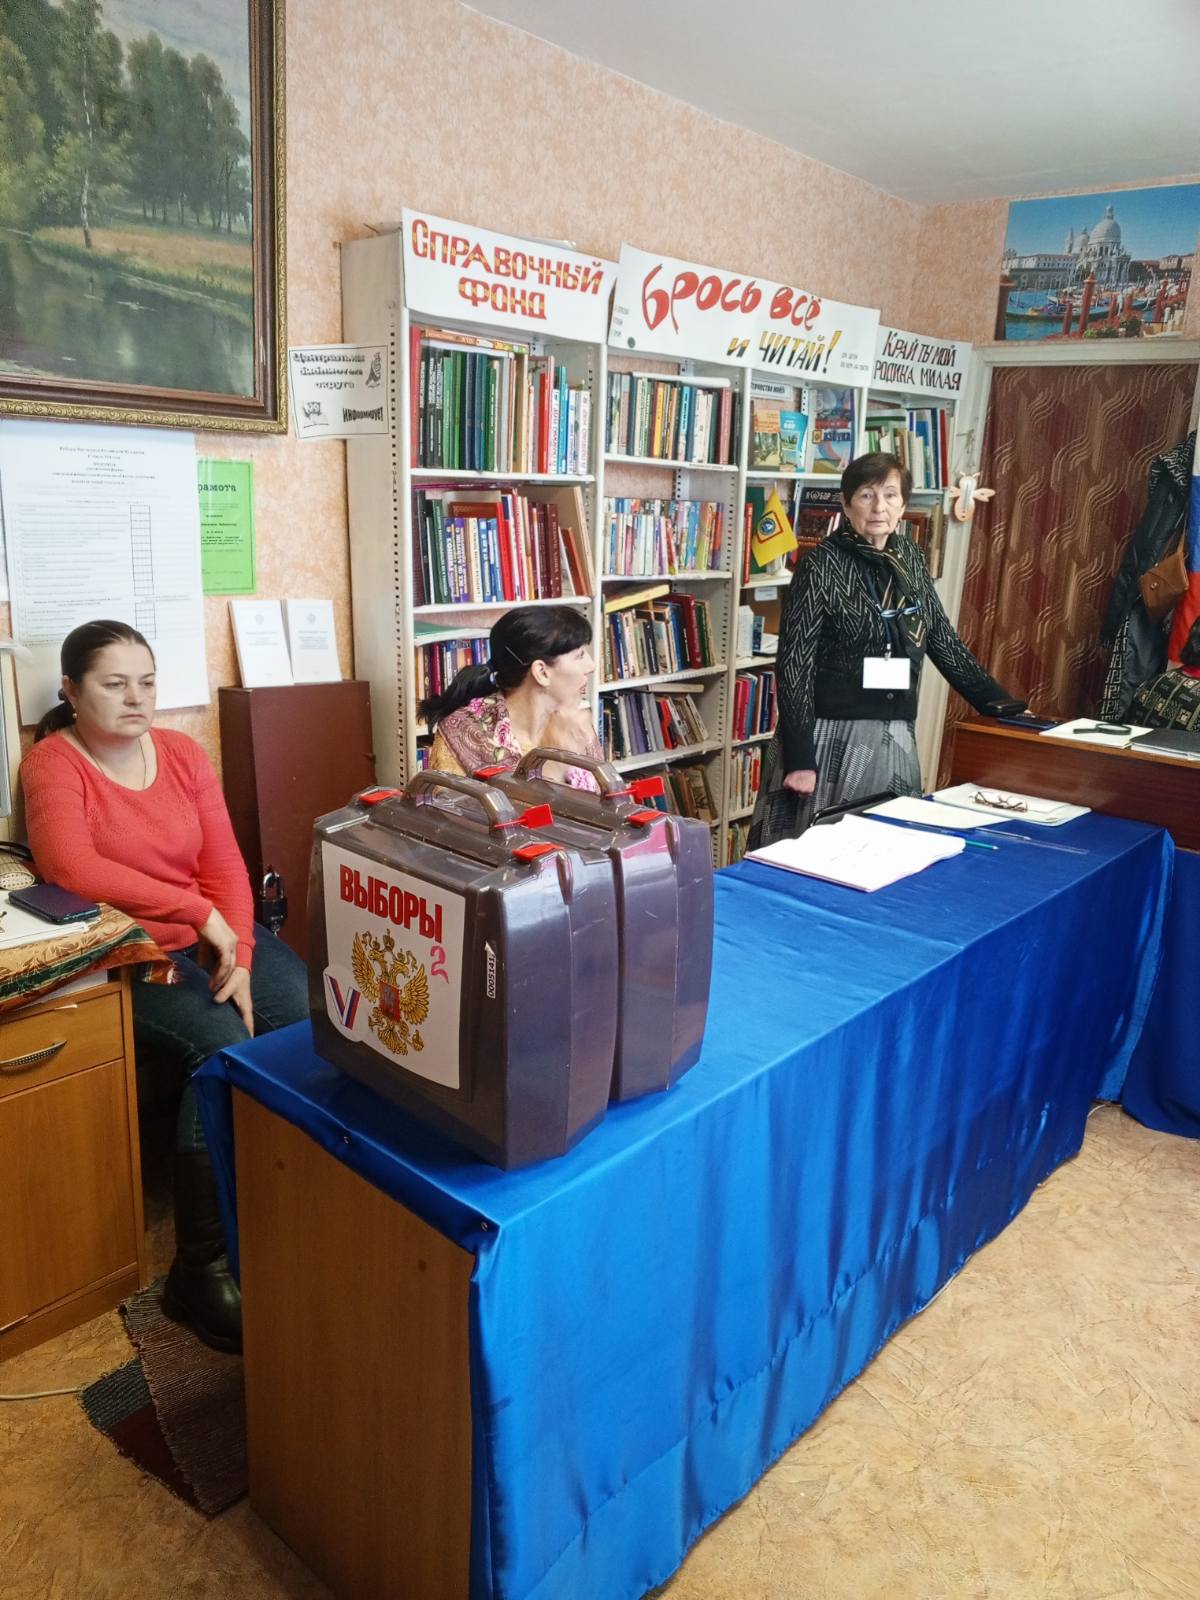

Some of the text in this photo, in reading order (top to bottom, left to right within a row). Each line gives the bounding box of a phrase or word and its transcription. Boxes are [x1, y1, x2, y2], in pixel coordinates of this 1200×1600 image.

[411, 218, 604, 295] СПРАВОЧНЫЙ
[458, 276, 547, 320] ФОНД
[917, 343, 934, 363] ТЫ
[874, 360, 962, 391] РОДИНА МИЛАЯ
[339, 863, 443, 944] ВЫБОРЫ
[429, 945, 449, 984] 2
